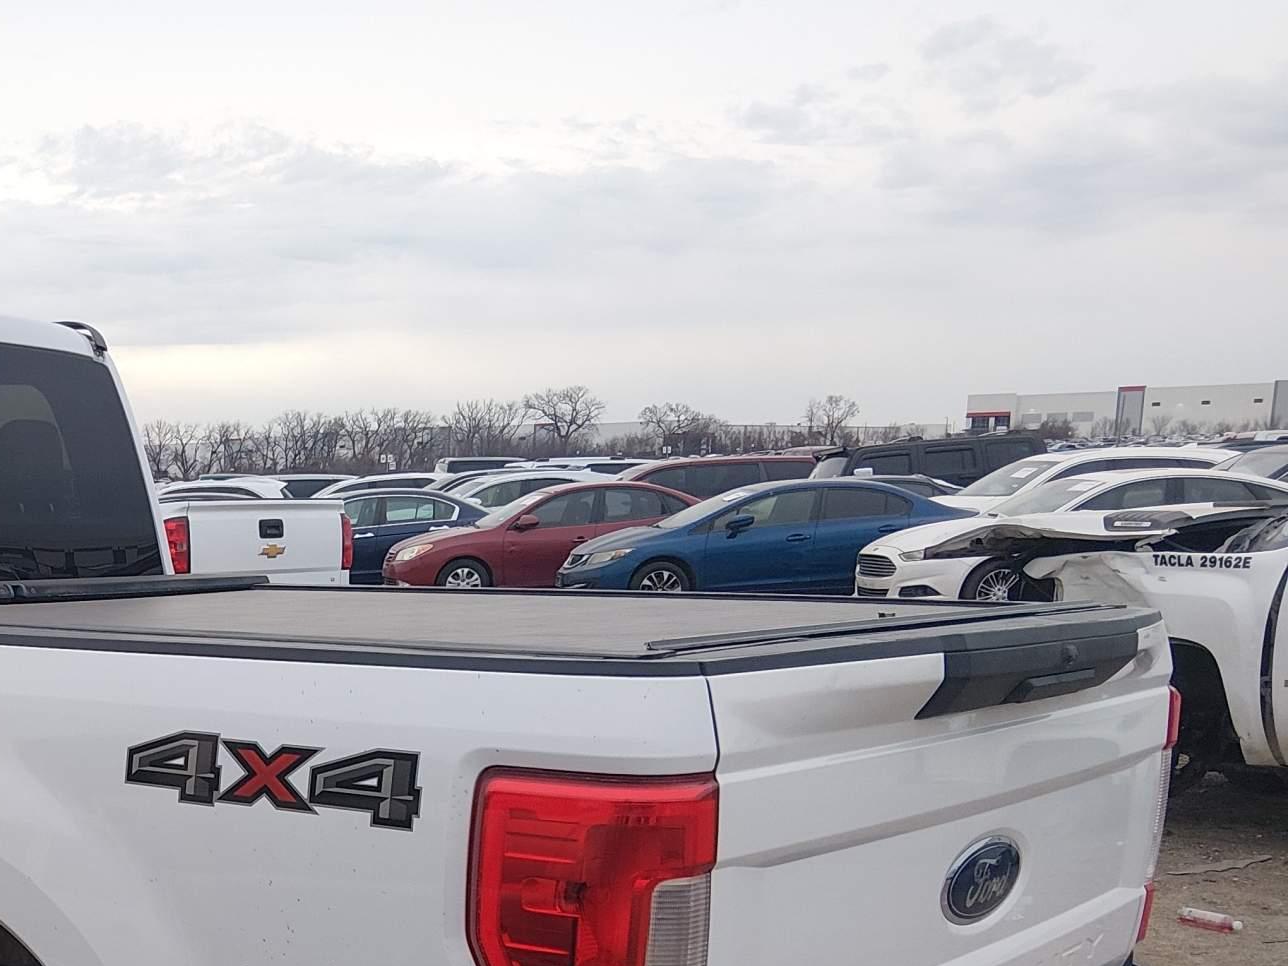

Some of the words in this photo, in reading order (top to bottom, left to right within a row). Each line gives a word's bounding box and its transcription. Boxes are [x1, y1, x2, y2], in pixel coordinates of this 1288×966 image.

[1152, 554, 1194, 568] TACLA
[1200, 554, 1252, 569] 29162E
[966, 856, 1012, 908] Ford
